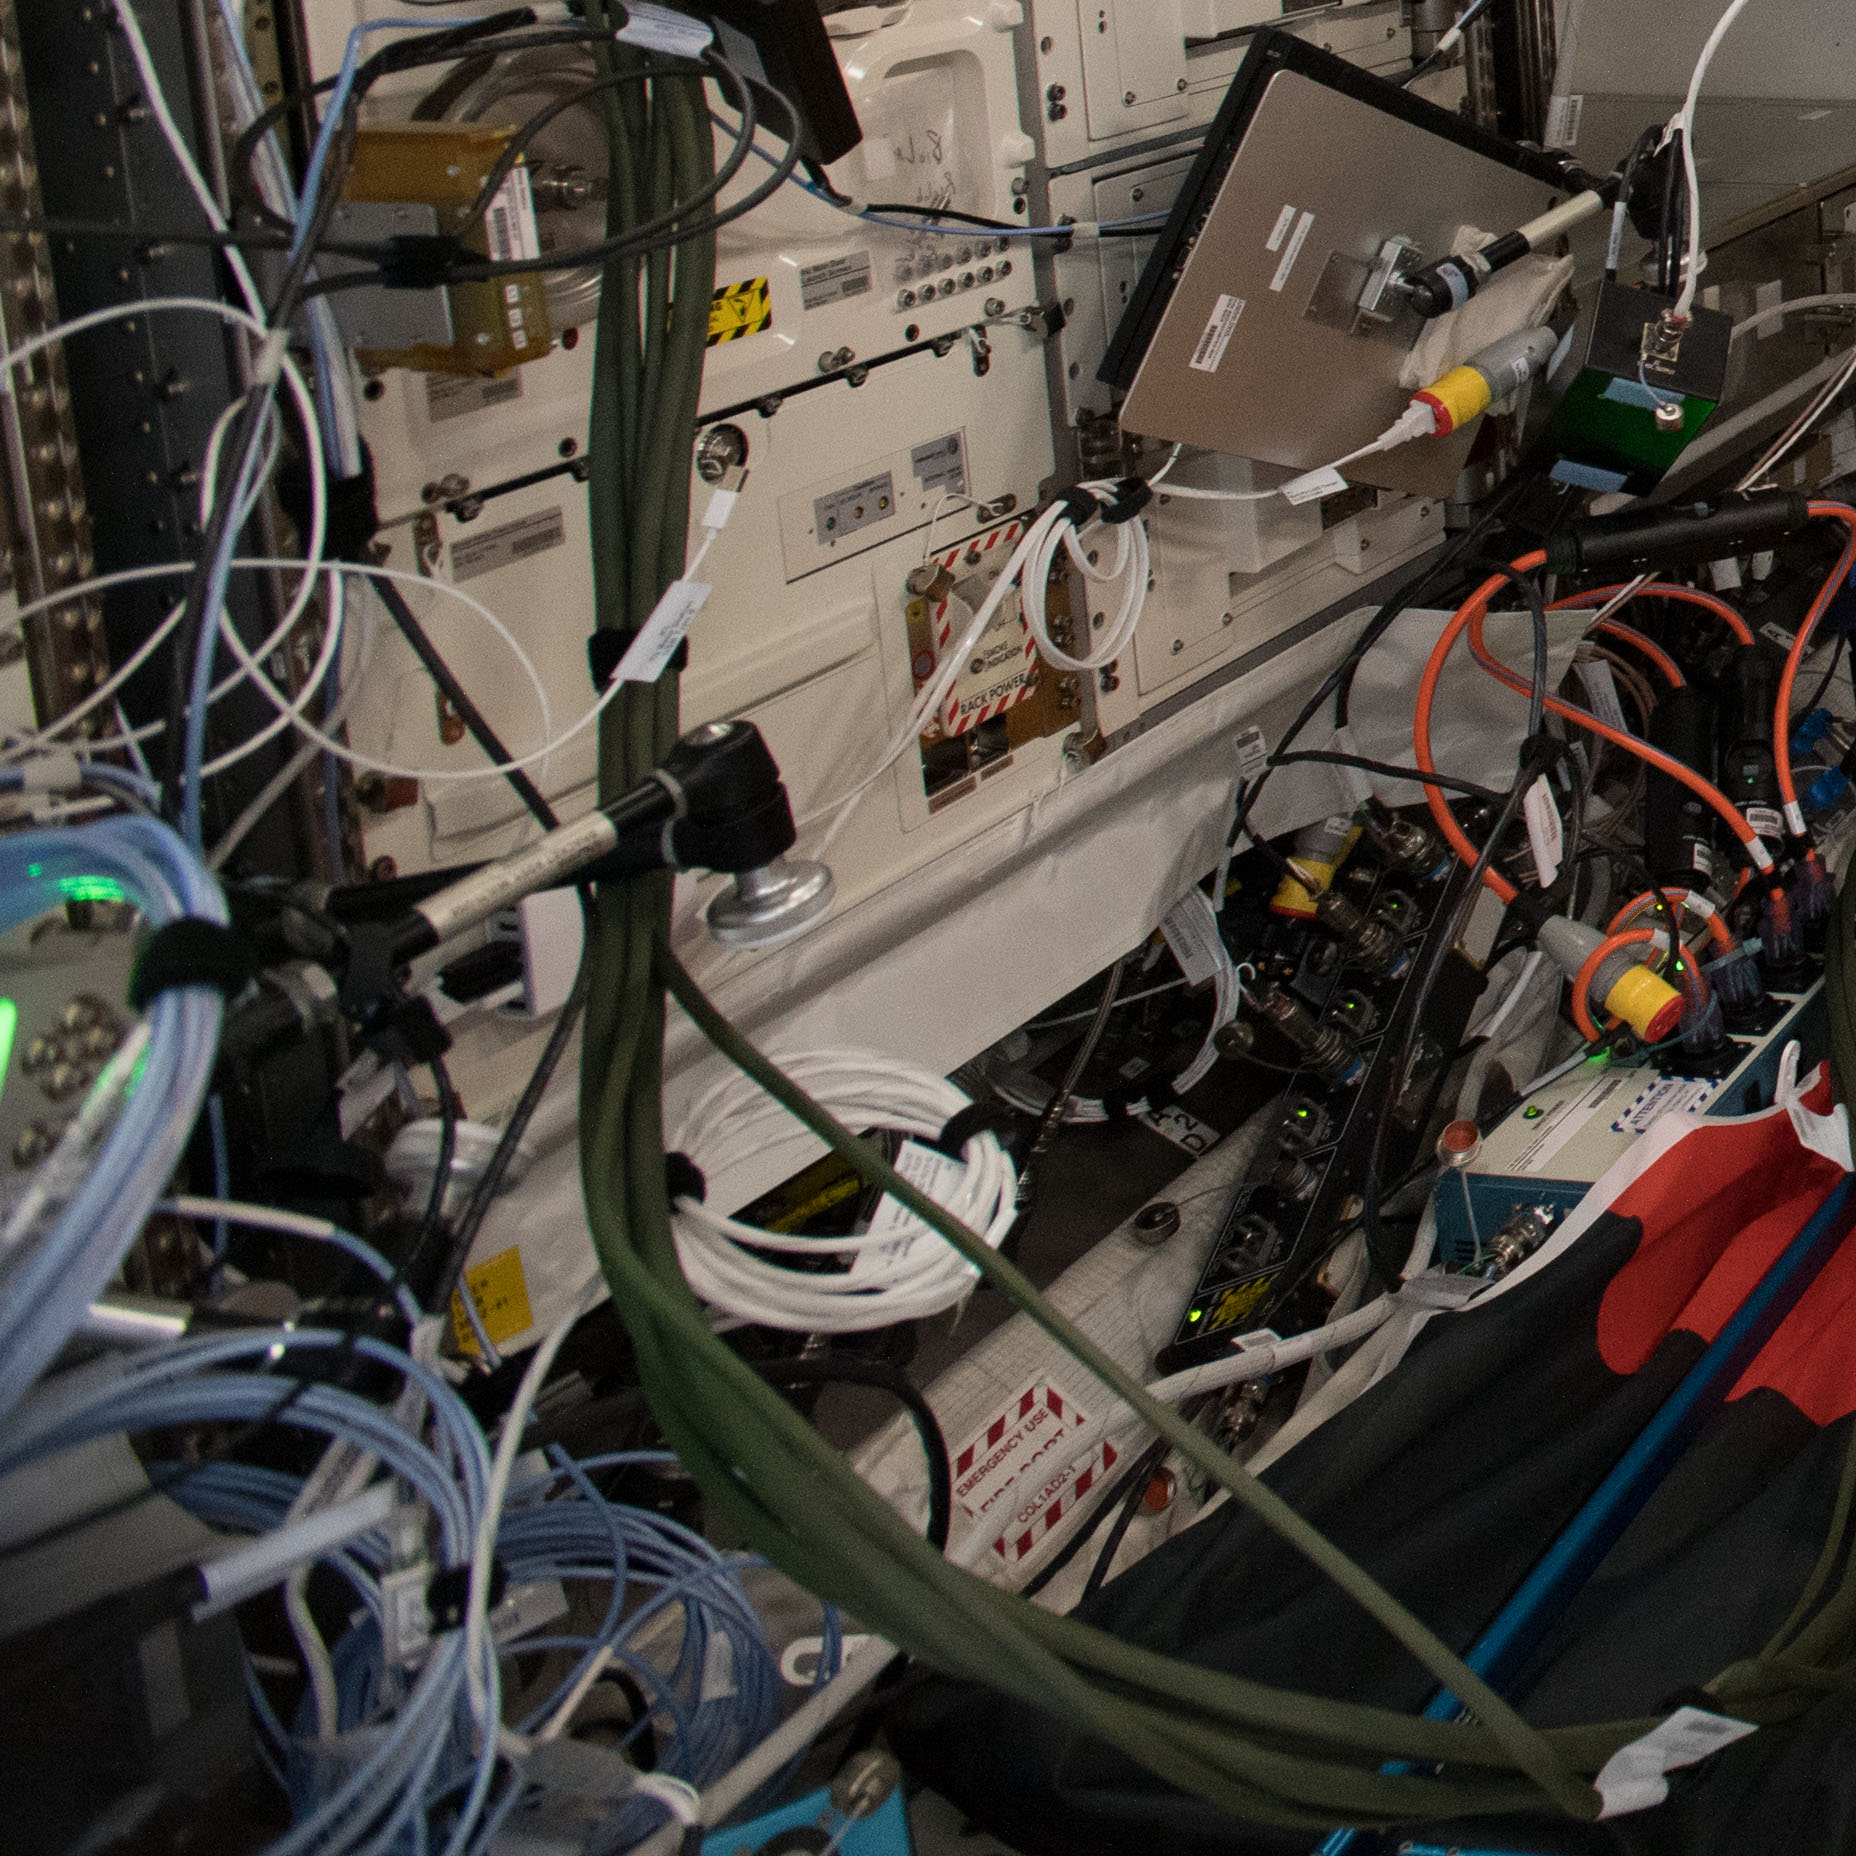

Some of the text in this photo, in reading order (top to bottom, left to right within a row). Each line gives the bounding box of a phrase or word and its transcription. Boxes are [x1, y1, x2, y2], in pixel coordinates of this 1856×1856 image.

[960, 673, 1025, 715] RACK POWER
[956, 1431, 1024, 1497] EMERGENCY
[1024, 1407, 1048, 1432] USE
[1017, 1464, 1076, 1523] COL1AD2-1
